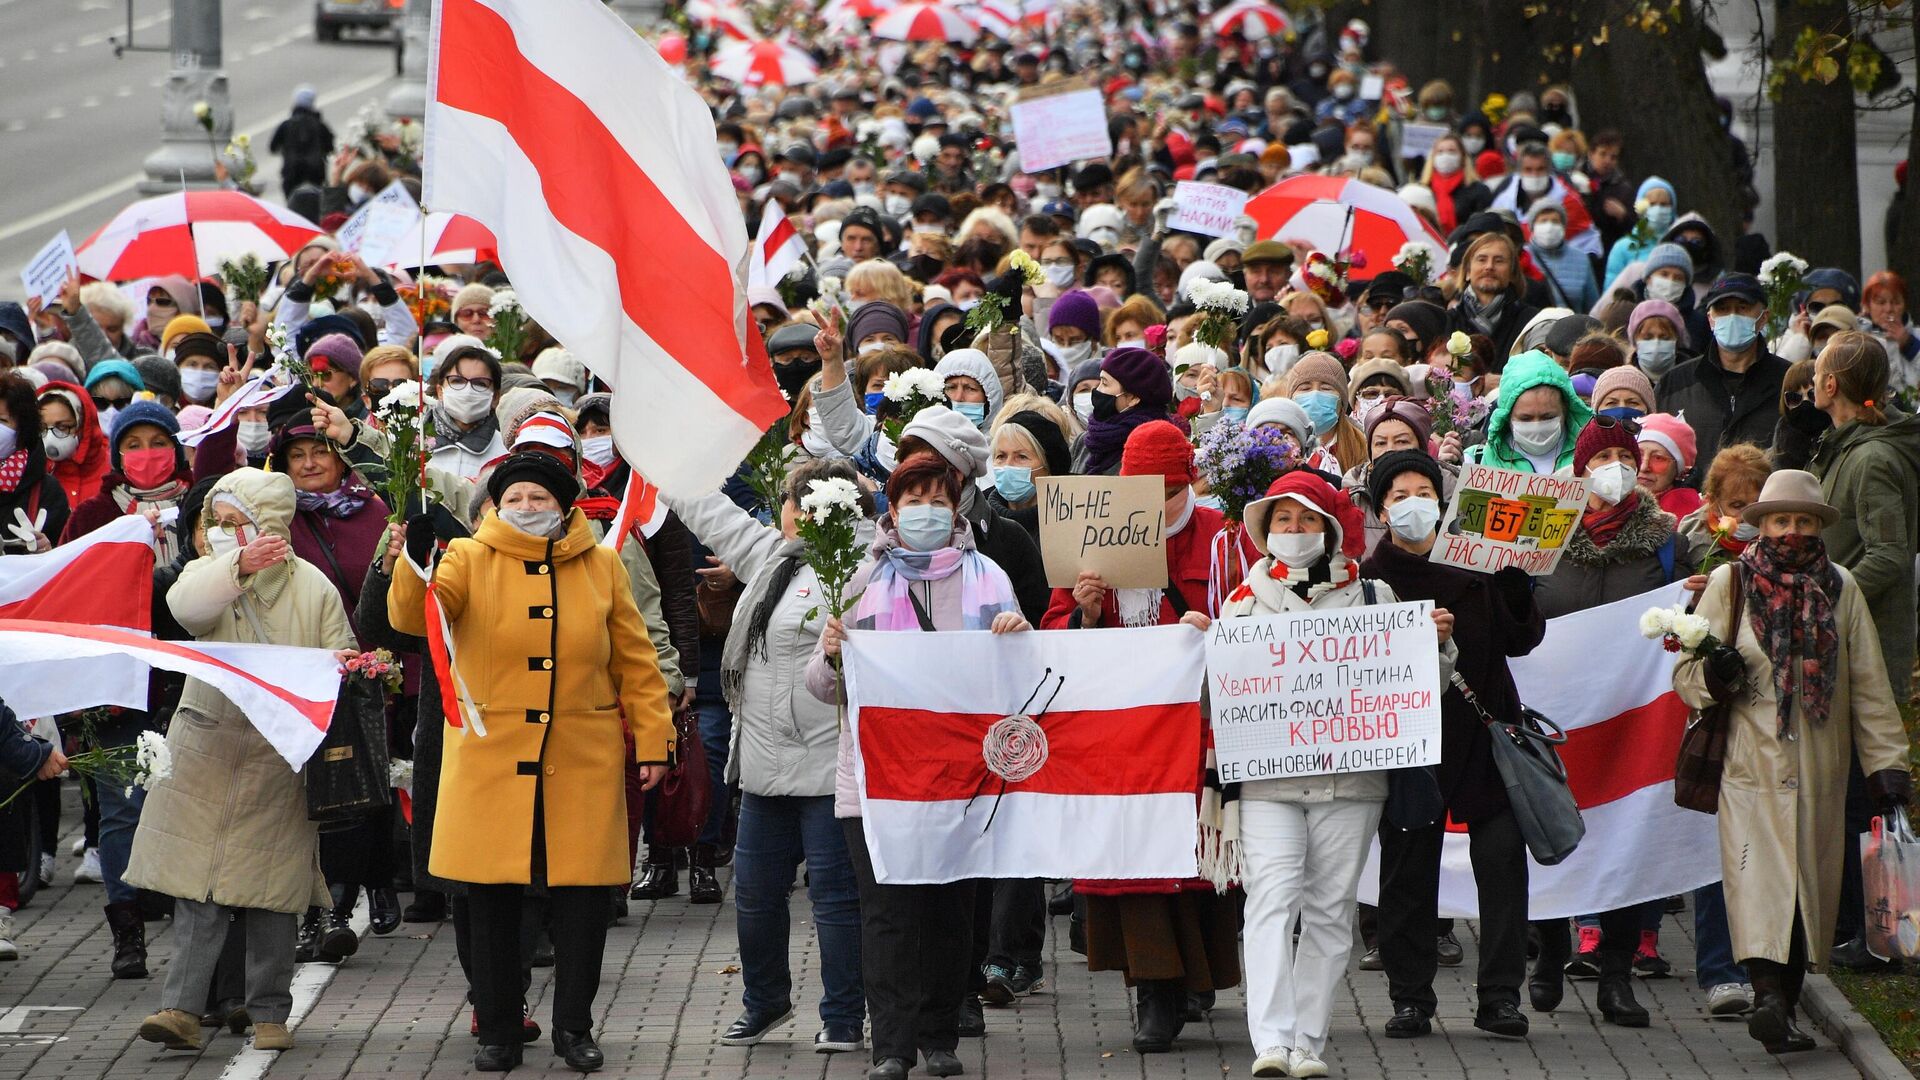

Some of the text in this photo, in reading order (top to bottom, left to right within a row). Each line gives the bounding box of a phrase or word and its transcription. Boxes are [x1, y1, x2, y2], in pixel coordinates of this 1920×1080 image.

[1180, 208, 1236, 231] НАСИЛИ
[1465, 467, 1585, 501] ХВАТИТ КОРМИТЬ
[1081, 510, 1162, 558] рабы!
[1490, 509, 1521, 534] БТ
[1529, 507, 1542, 532] СТВ
[1542, 523, 1569, 540] ОНТ
[1444, 538, 1483, 566] НАС
[1290, 602, 1425, 640] ПРОМАХНУЛСЯ!
[1216, 673, 1284, 697] ХВАТИТ
[1220, 688, 1431, 726] КРАСИТЬ ФАСАД БЕЛАРУСИ
[1290, 712, 1399, 747] КРОВЬЮ
[1222, 762, 1240, 781] ЕЕ
[1336, 739, 1427, 774] ДОЧЕРЕЙ!
